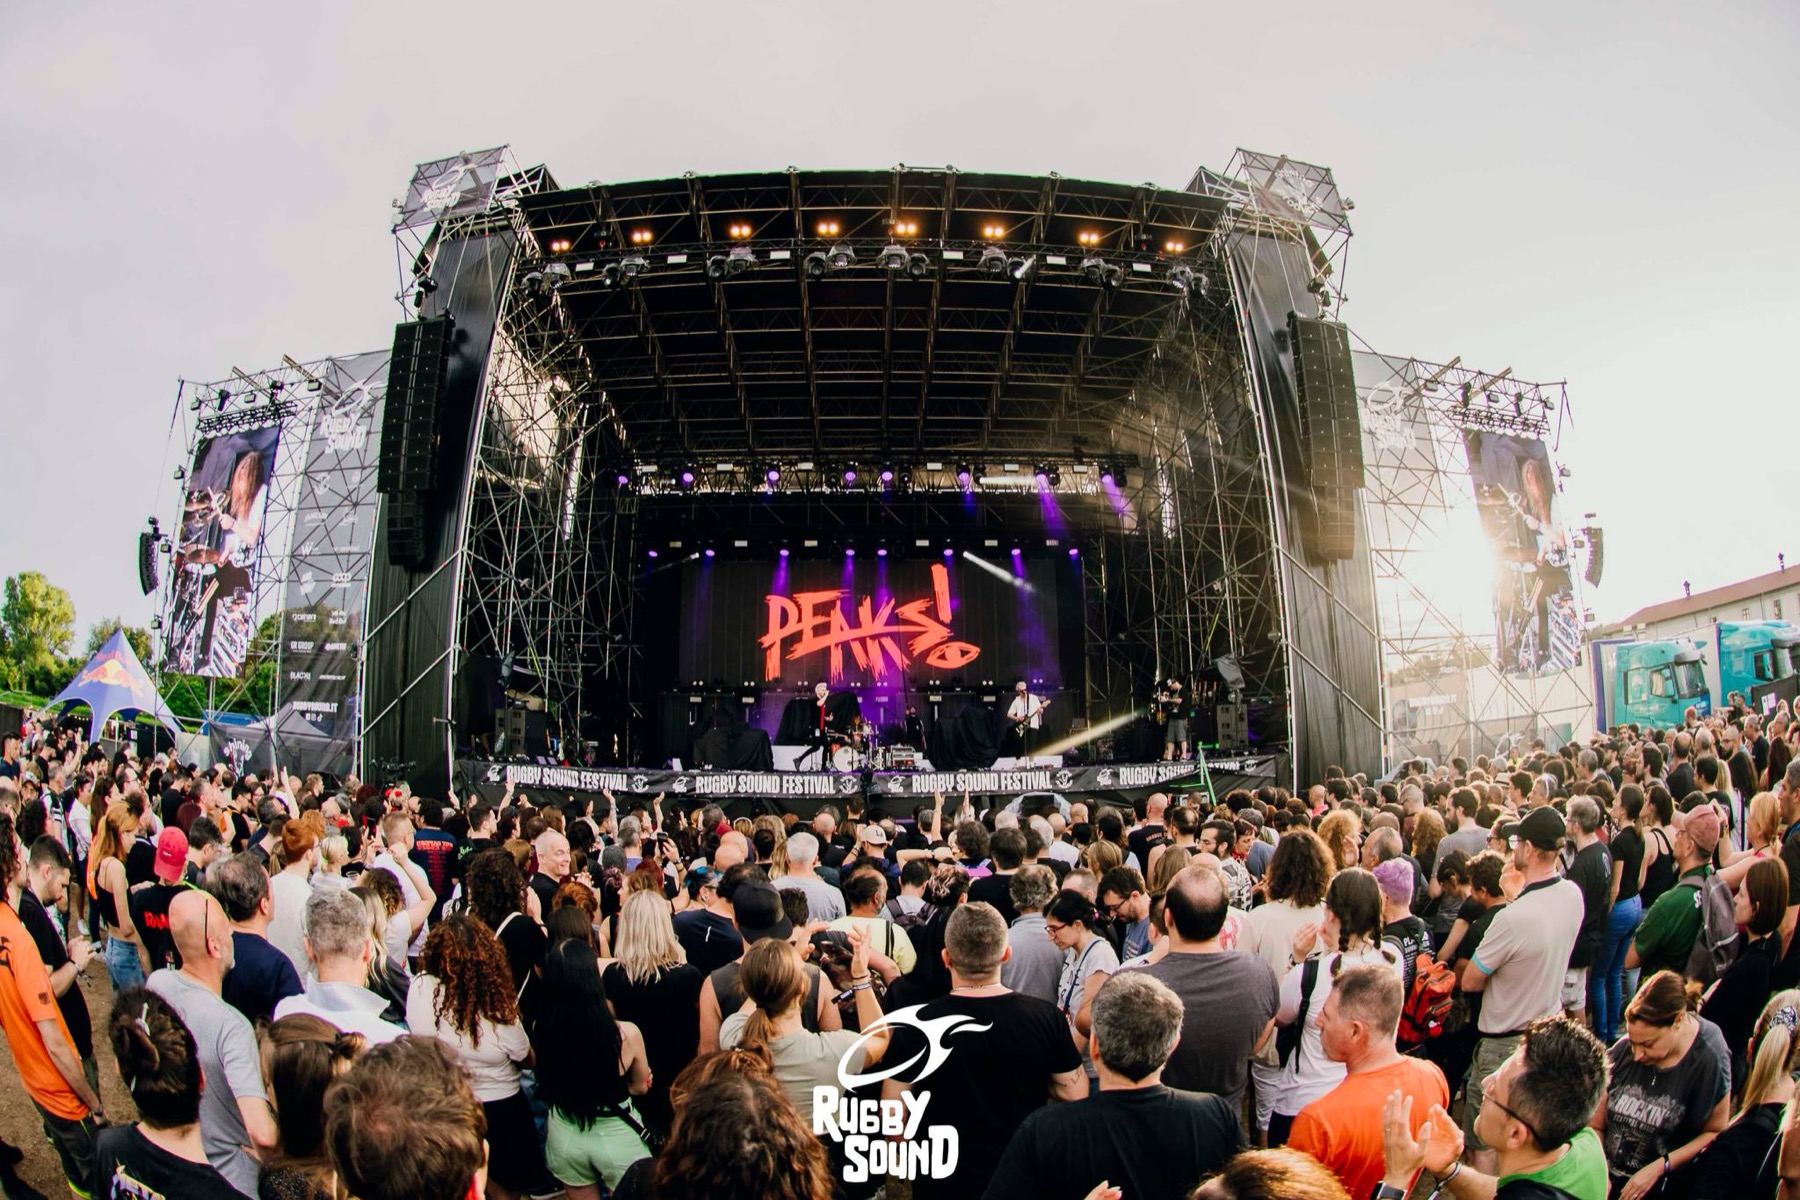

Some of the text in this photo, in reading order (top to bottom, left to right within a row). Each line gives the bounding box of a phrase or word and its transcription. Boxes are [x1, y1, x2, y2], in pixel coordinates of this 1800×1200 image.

[320, 413, 358, 440] RUGBY
[324, 425, 367, 455] SOUND
[758, 563, 978, 685] PEAKS!
[507, 765, 629, 791] RUGBY SOUND FESTIVAL
[695, 775, 836, 794] RUGBY SOUND FESTIVAL
[912, 770, 1053, 793] RUGBY SOUND FESTIVAL
[1119, 766, 1158, 786] RUGBY
